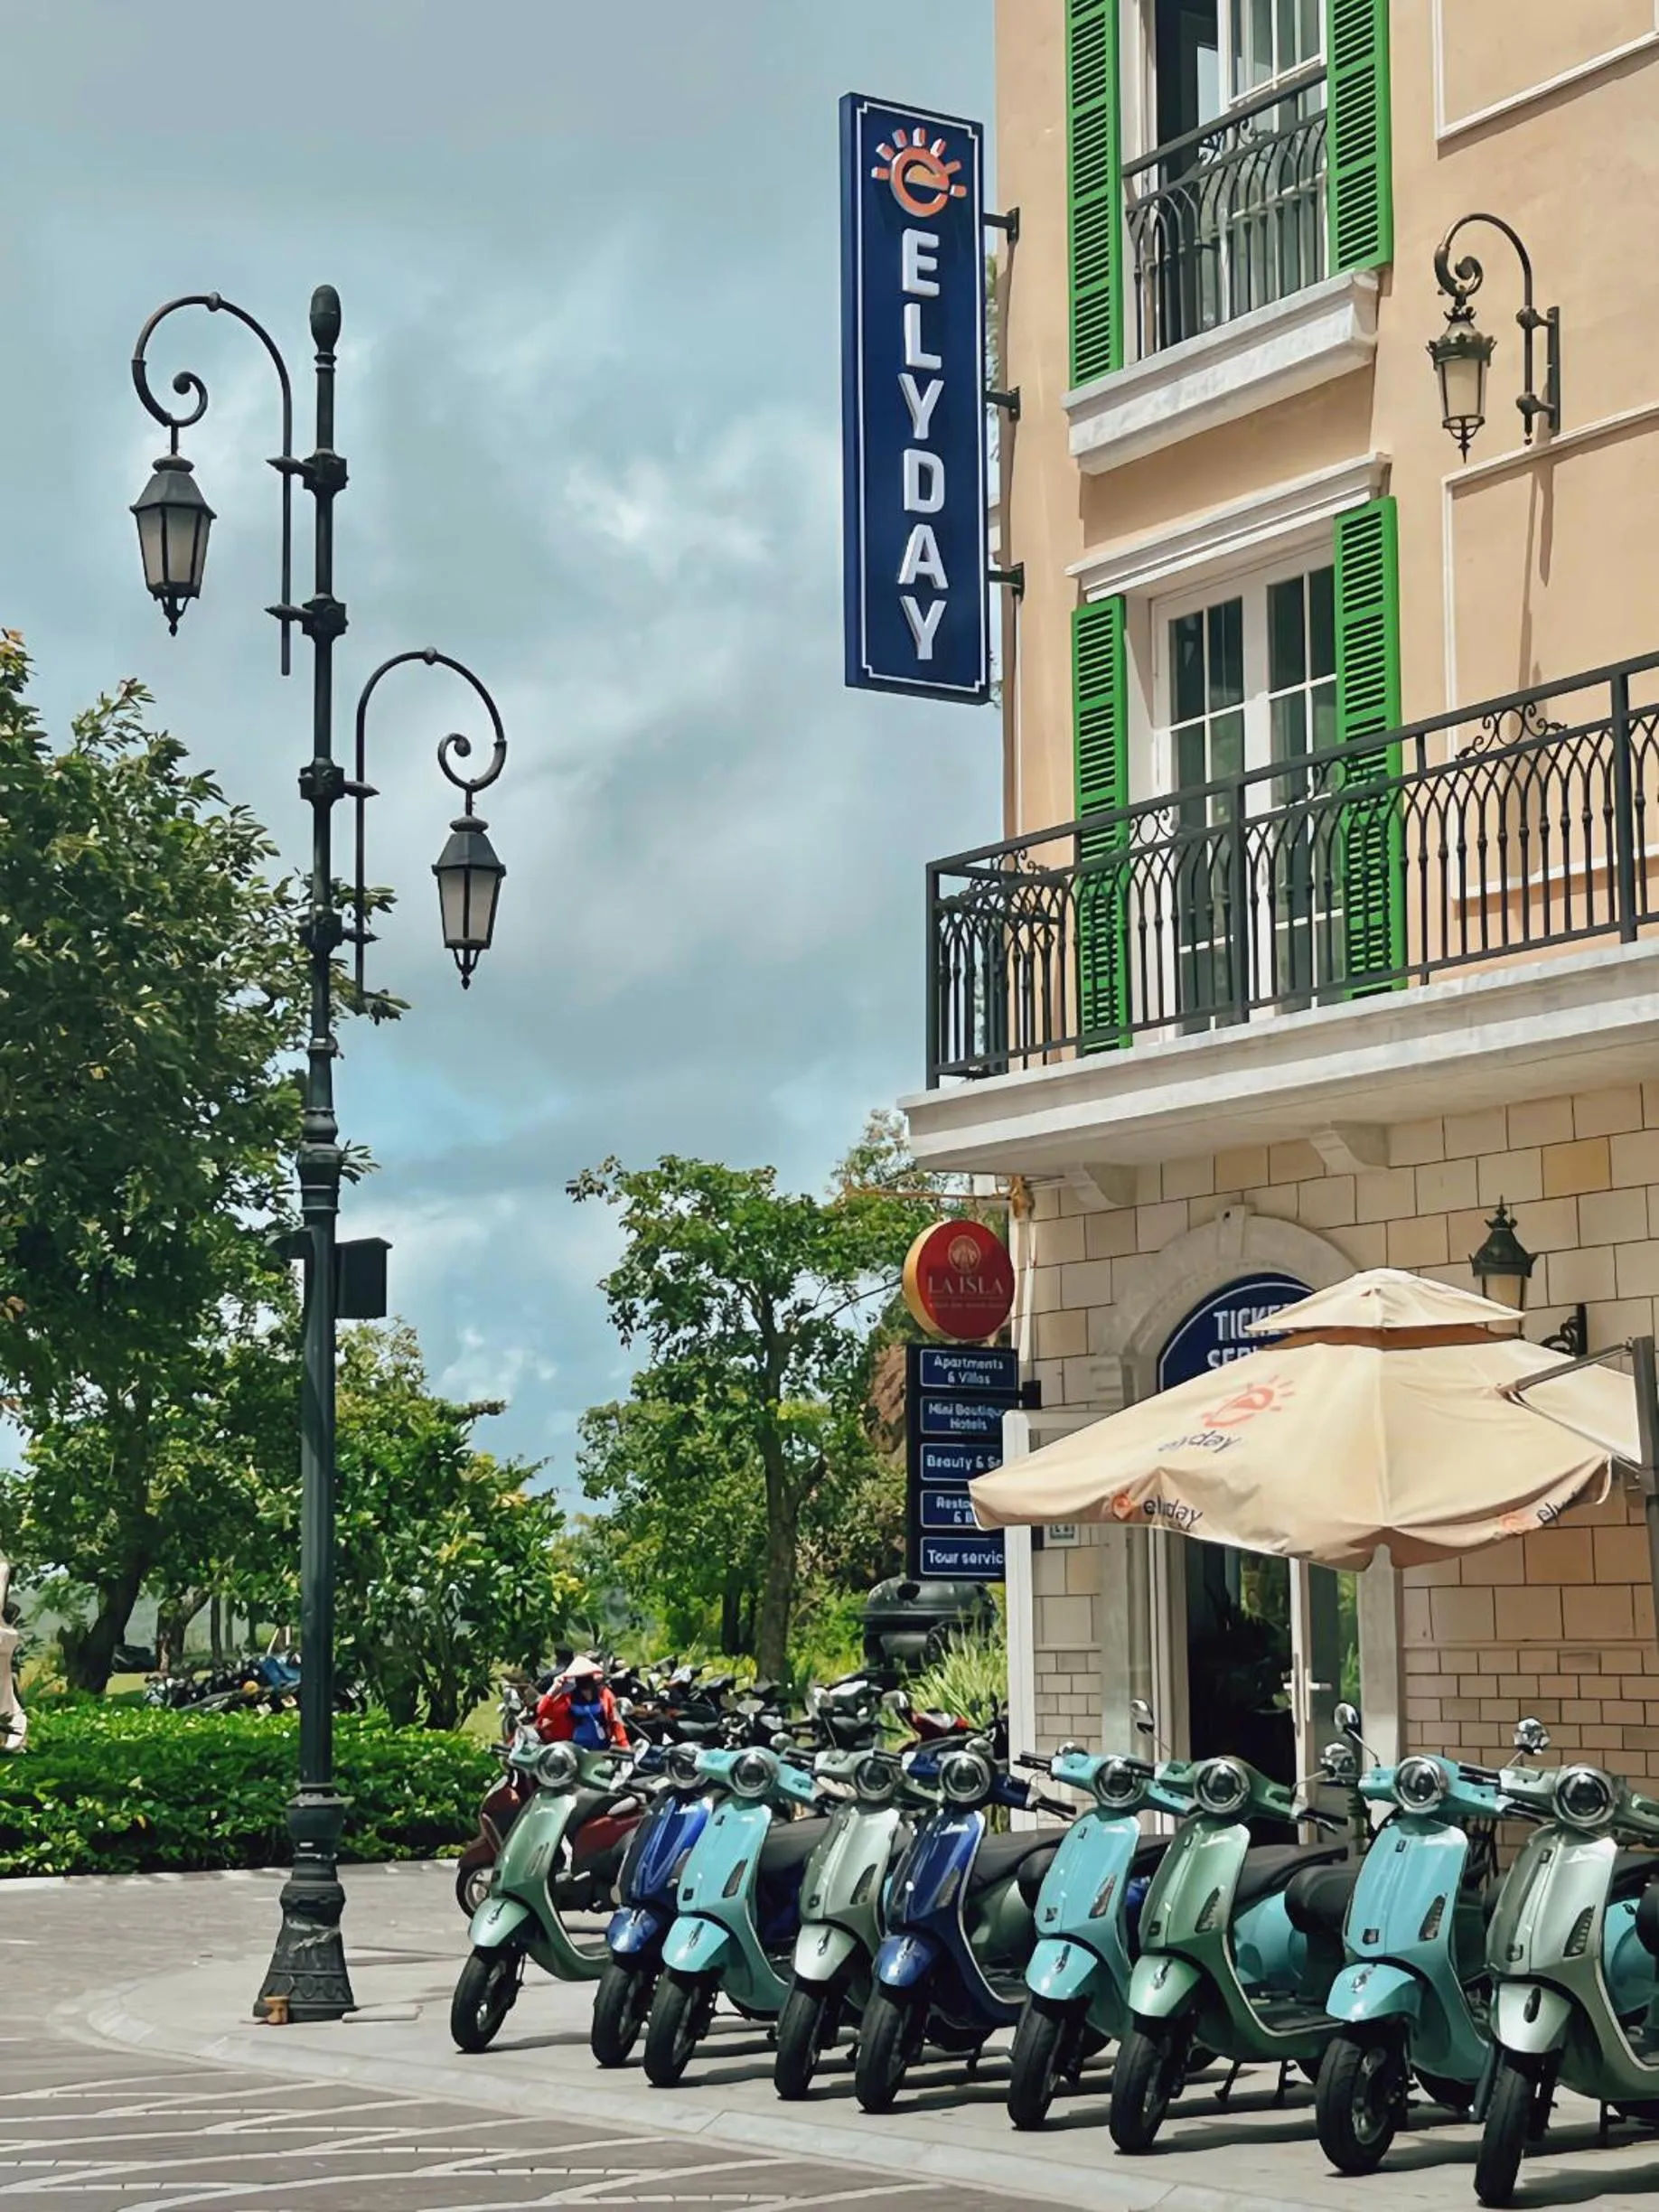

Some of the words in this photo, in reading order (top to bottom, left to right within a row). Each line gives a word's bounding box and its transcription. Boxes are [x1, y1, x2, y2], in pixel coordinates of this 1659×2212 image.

[896, 227, 950, 661] ELYDAY
[928, 1275, 953, 1295] LA
[959, 1275, 1004, 1295] ISLA
[1213, 1304, 1292, 1341] TICK
[933, 1354, 1004, 1370] Apartments
[958, 1371, 990, 1384] Villas
[955, 1402, 1004, 1419] Boutiqu
[950, 1418, 988, 1430] Hotels
[926, 1454, 972, 1471] Beauty
[927, 1549, 958, 1564] Tour
[961, 1550, 1004, 1565] servic
